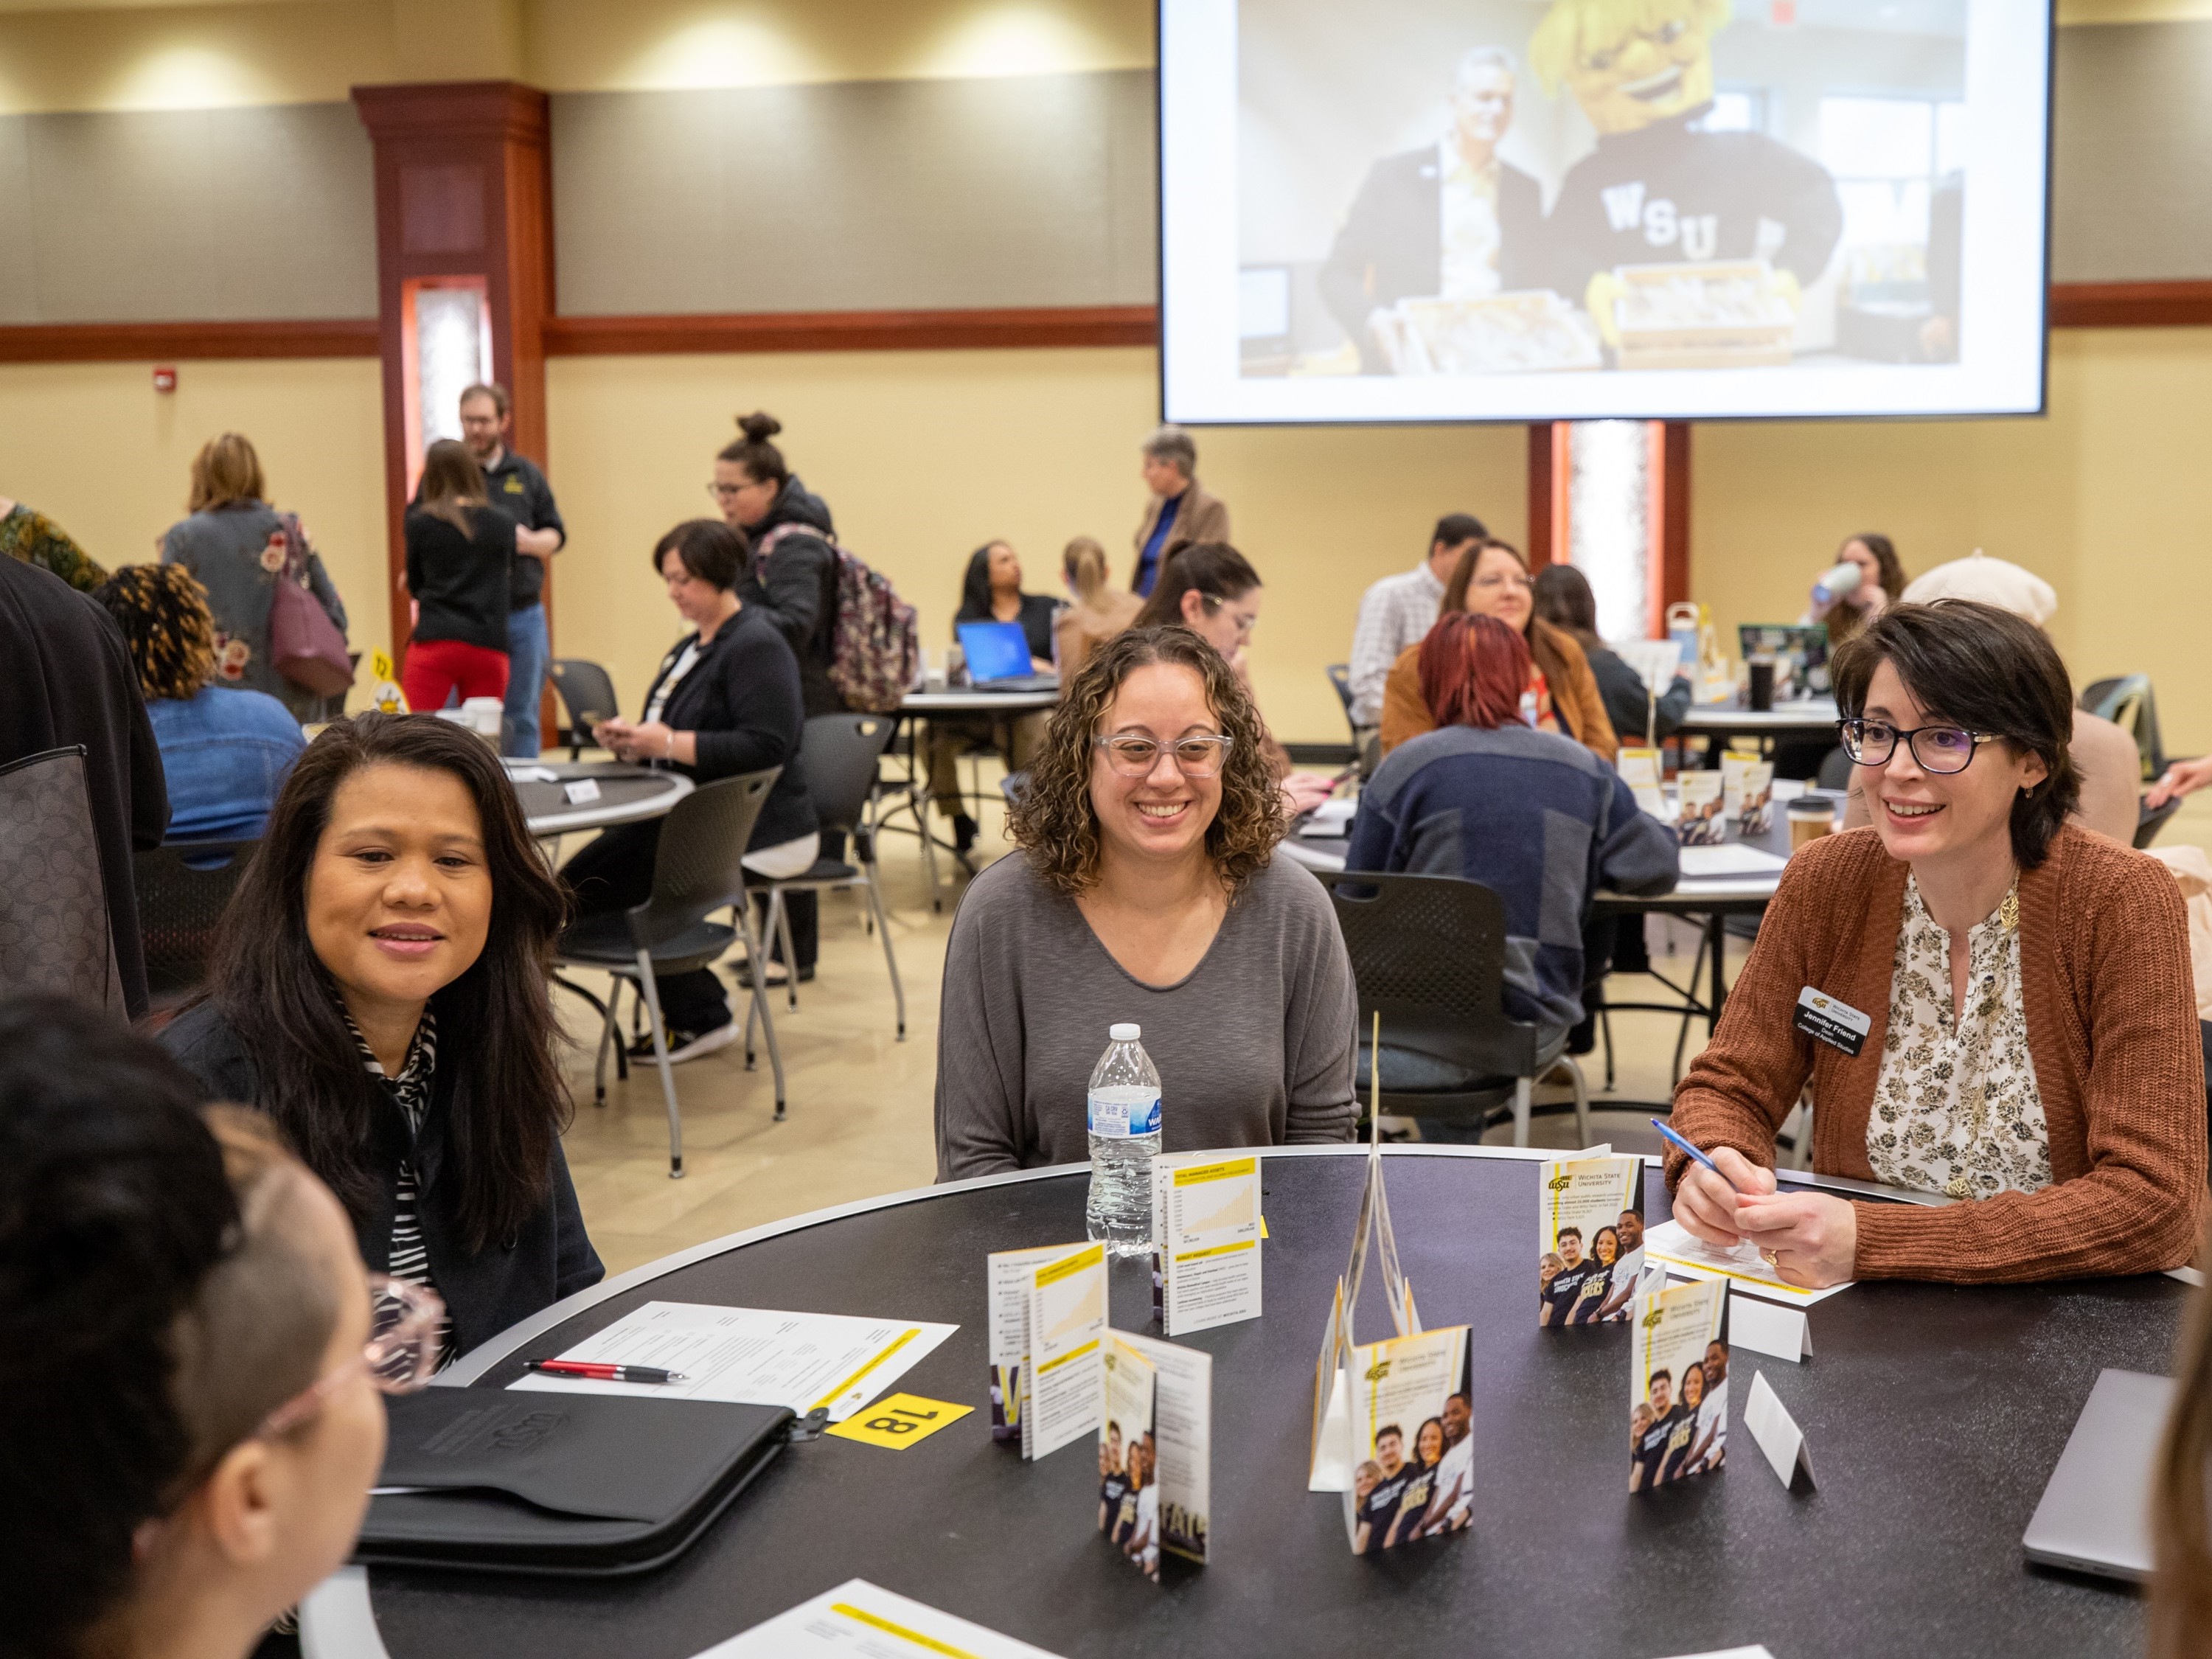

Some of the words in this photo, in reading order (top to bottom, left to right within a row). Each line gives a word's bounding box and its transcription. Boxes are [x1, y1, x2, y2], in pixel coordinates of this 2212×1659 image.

[1600, 180, 1719, 260] WSU
[1798, 1022, 1815, 1034] College
[1819, 1033, 1837, 1046] Applied
[1837, 1042, 1854, 1054] Studies
[1804, 1011, 1832, 1028] Jennifer
[1833, 1024, 1857, 1041] Friend
[1820, 1027, 1834, 1037] Dean
[864, 1408, 939, 1434] 18
